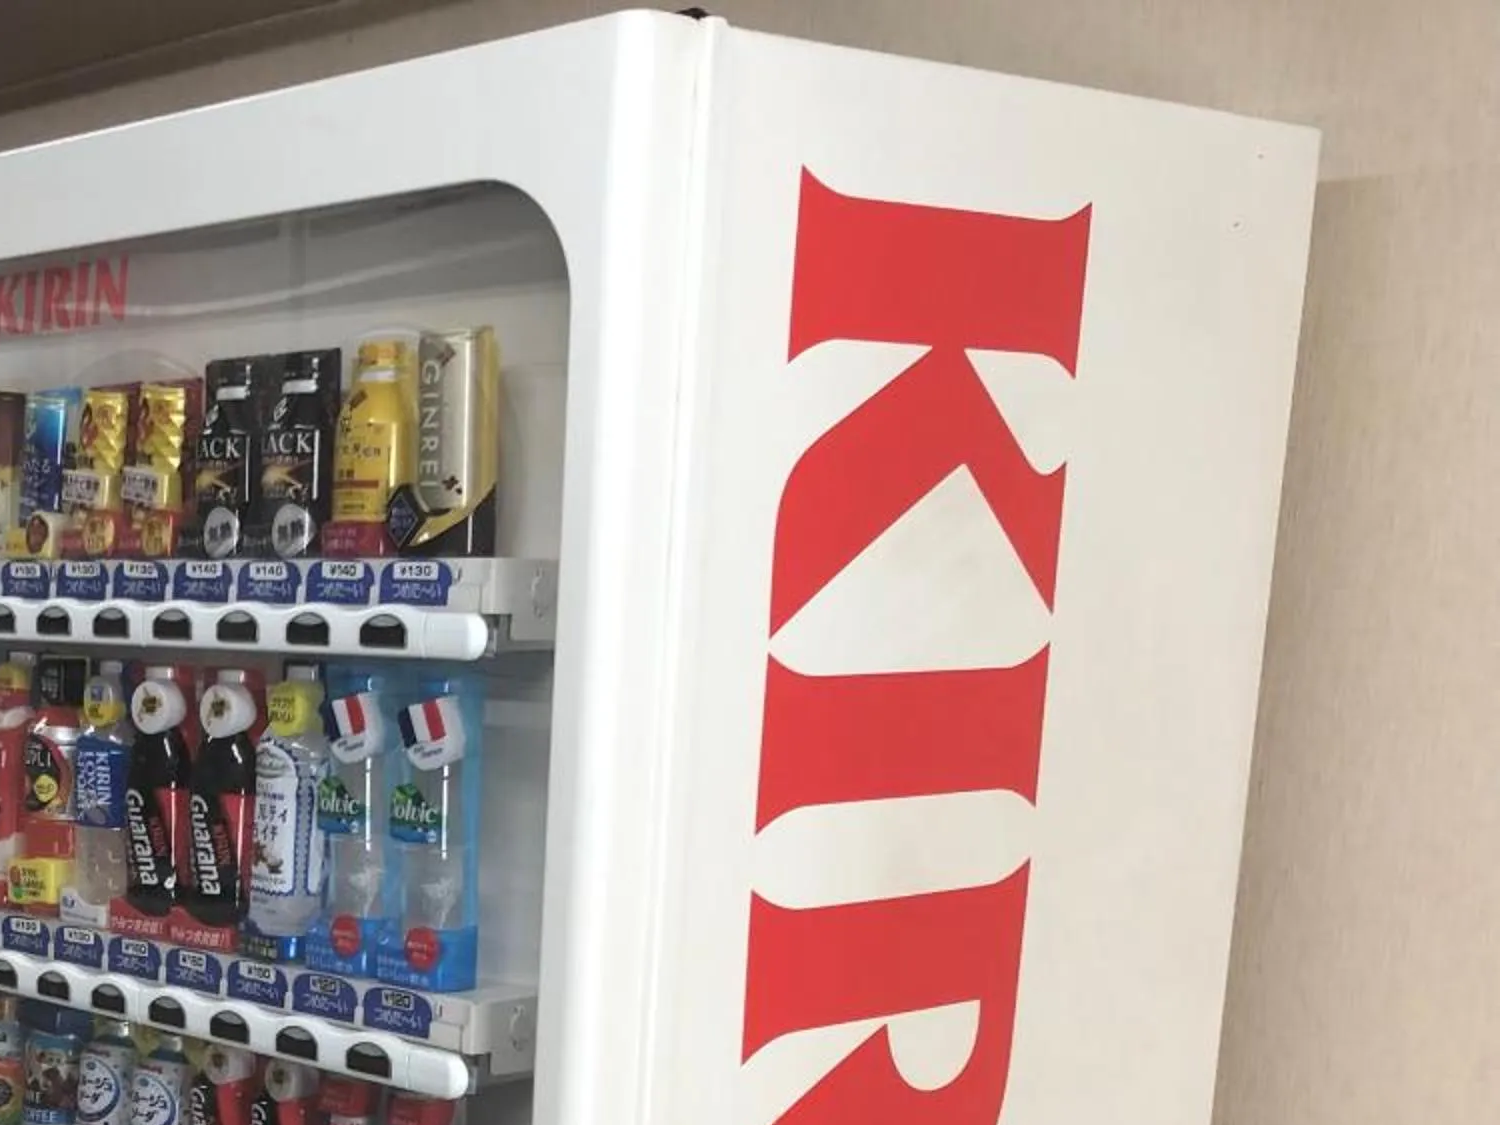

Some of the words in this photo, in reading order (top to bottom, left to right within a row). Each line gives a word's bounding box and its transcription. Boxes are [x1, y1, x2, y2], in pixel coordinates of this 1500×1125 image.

[419, 360, 441, 488] GINREI
[95, 750, 112, 806] KIRIN
[125, 789, 159, 886] Guarana
[190, 794, 221, 895] Guarana
